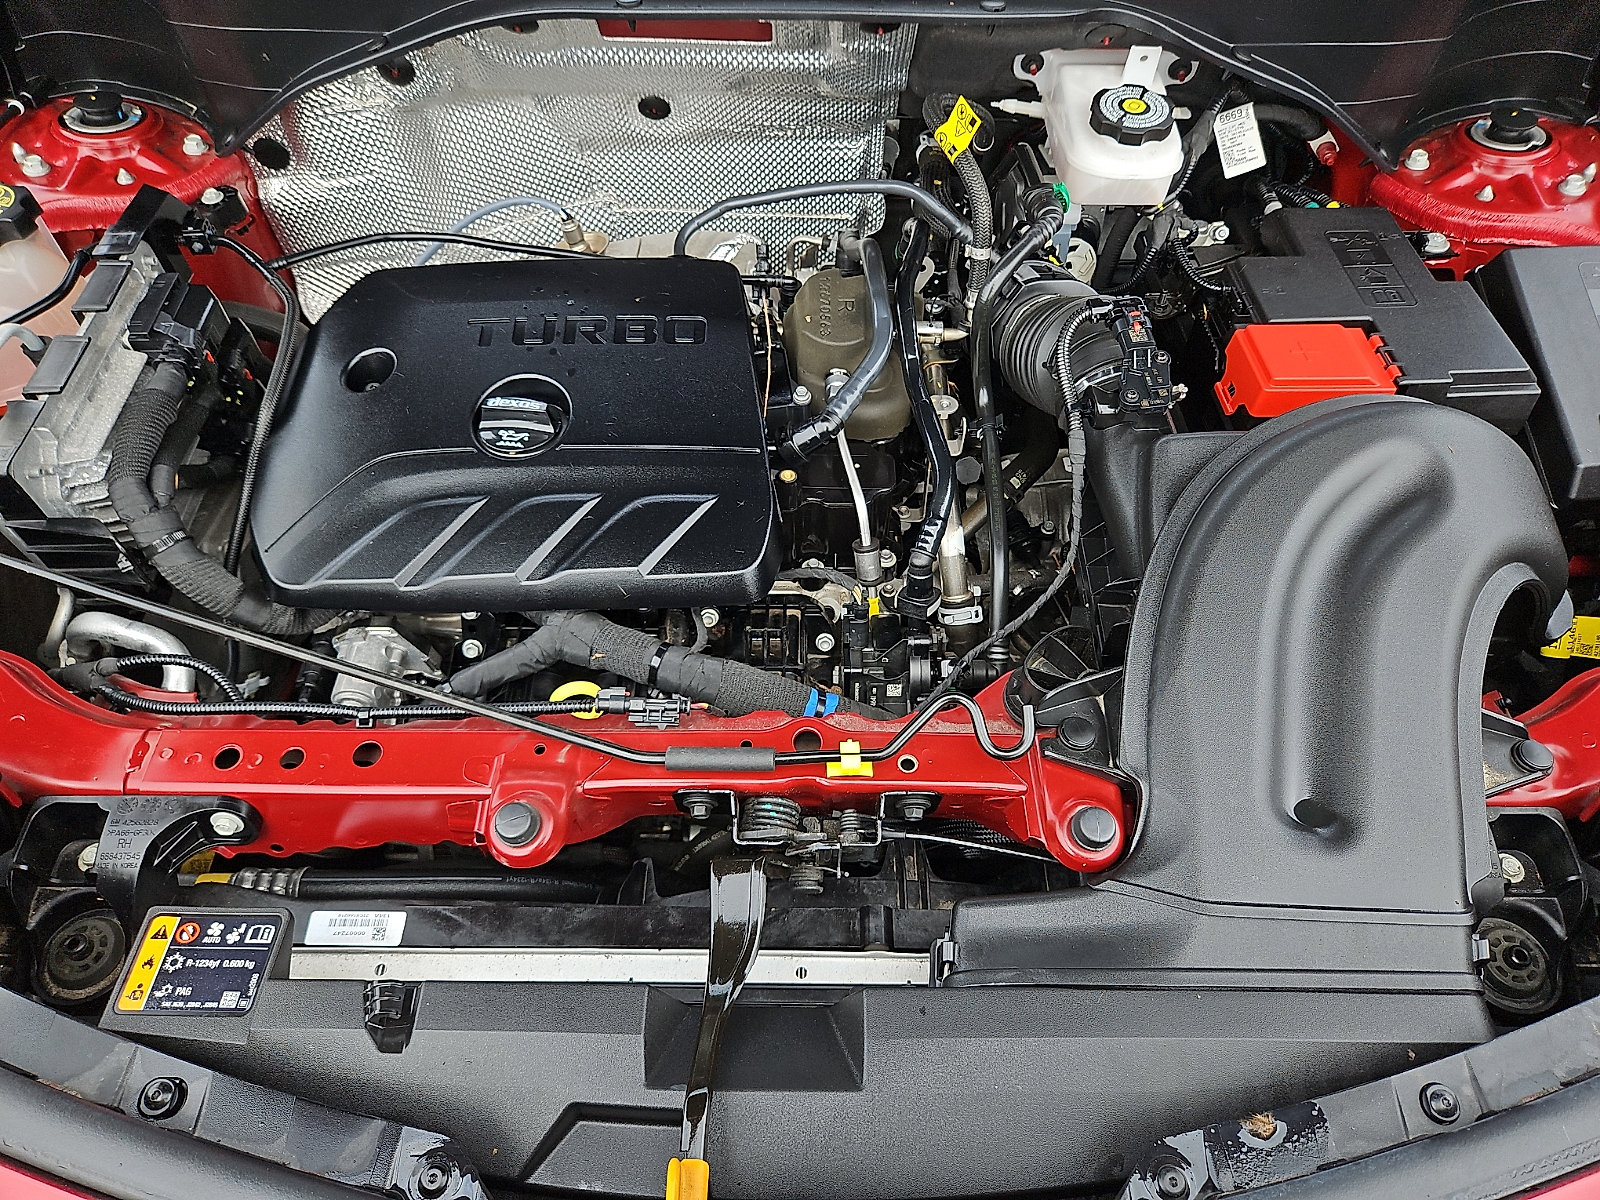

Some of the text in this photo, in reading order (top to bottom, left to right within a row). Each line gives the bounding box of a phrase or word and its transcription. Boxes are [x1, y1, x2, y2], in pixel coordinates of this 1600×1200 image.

[1219, 108, 1243, 124] 6669
[837, 297, 856, 312] R
[467, 314, 708, 348] TURBO
[486, 396, 541, 410] dexos
[117, 838, 132, 849] RH
[201, 935, 222, 944] AUTO
[185, 958, 256, 970] R-1234yf 0.600 kg
[174, 986, 193, 997] PAG
